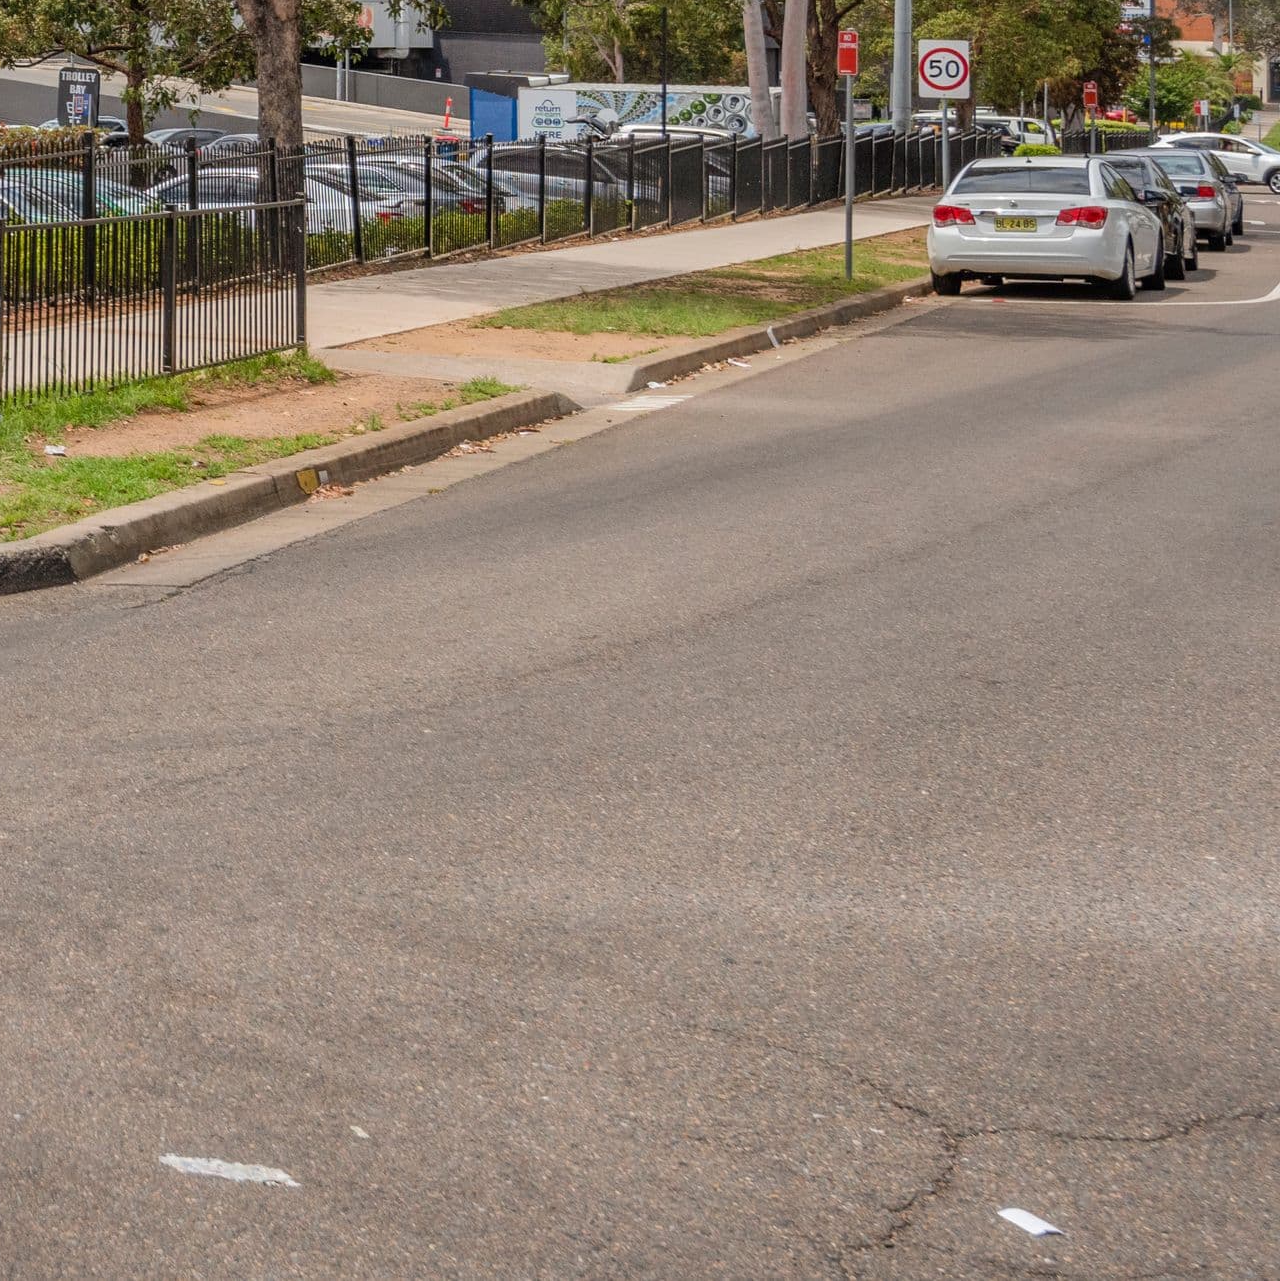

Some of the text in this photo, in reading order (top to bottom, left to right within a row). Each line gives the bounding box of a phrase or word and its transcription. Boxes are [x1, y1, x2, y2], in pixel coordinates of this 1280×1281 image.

[929, 59, 960, 79] 50
[61, 71, 96, 83] TROLLEY
[69, 84, 87, 95] BAY
[534, 130, 562, 139] HERE
